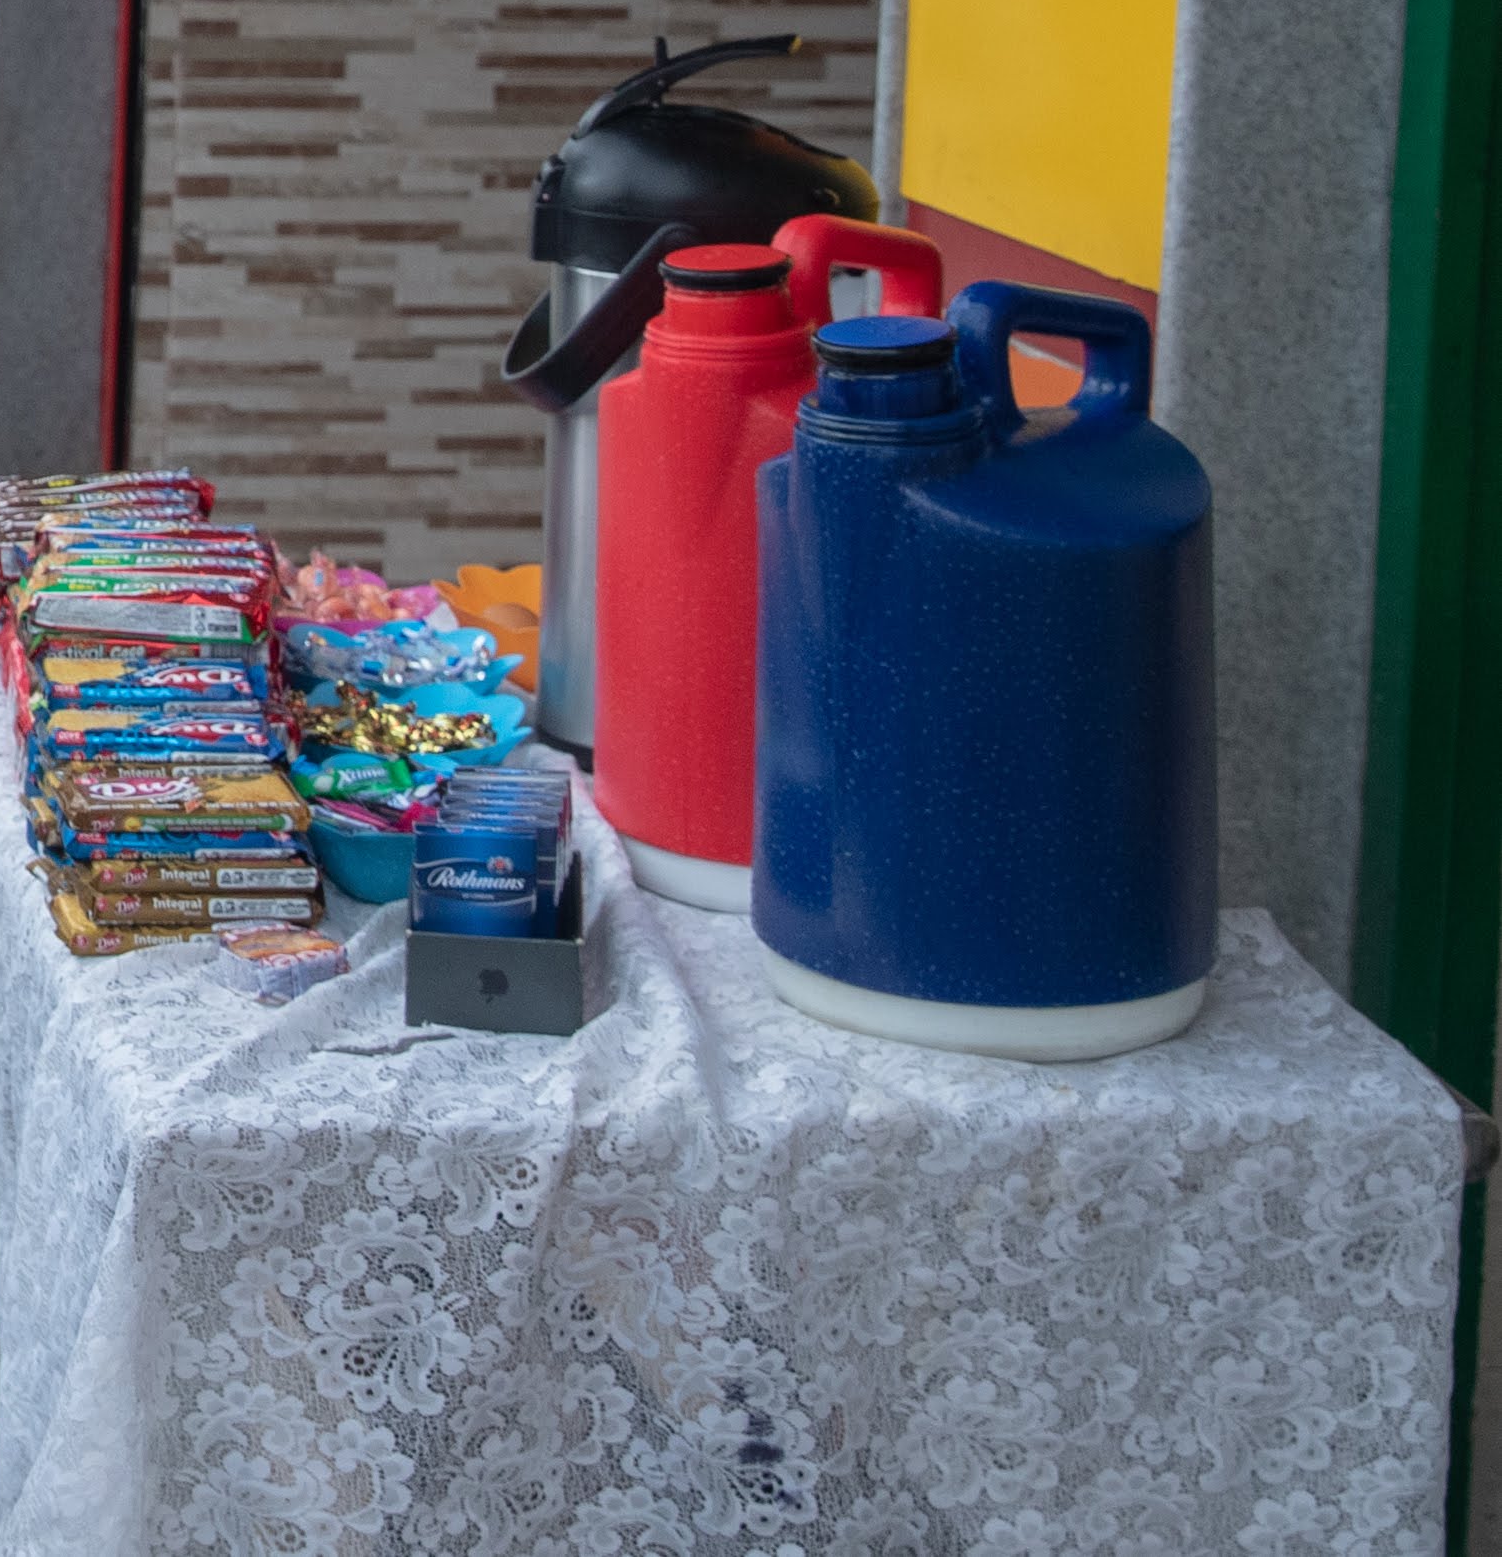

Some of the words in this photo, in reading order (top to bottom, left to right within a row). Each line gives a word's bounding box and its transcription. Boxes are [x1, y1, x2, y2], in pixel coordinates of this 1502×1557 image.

[118, 766, 166, 779] Integral
[89, 776, 195, 798] Dux
[160, 868, 210, 882] Integral
[427, 866, 526, 890] Rothmans
[152, 897, 203, 912] Integral
[134, 932, 183, 946] Integral
